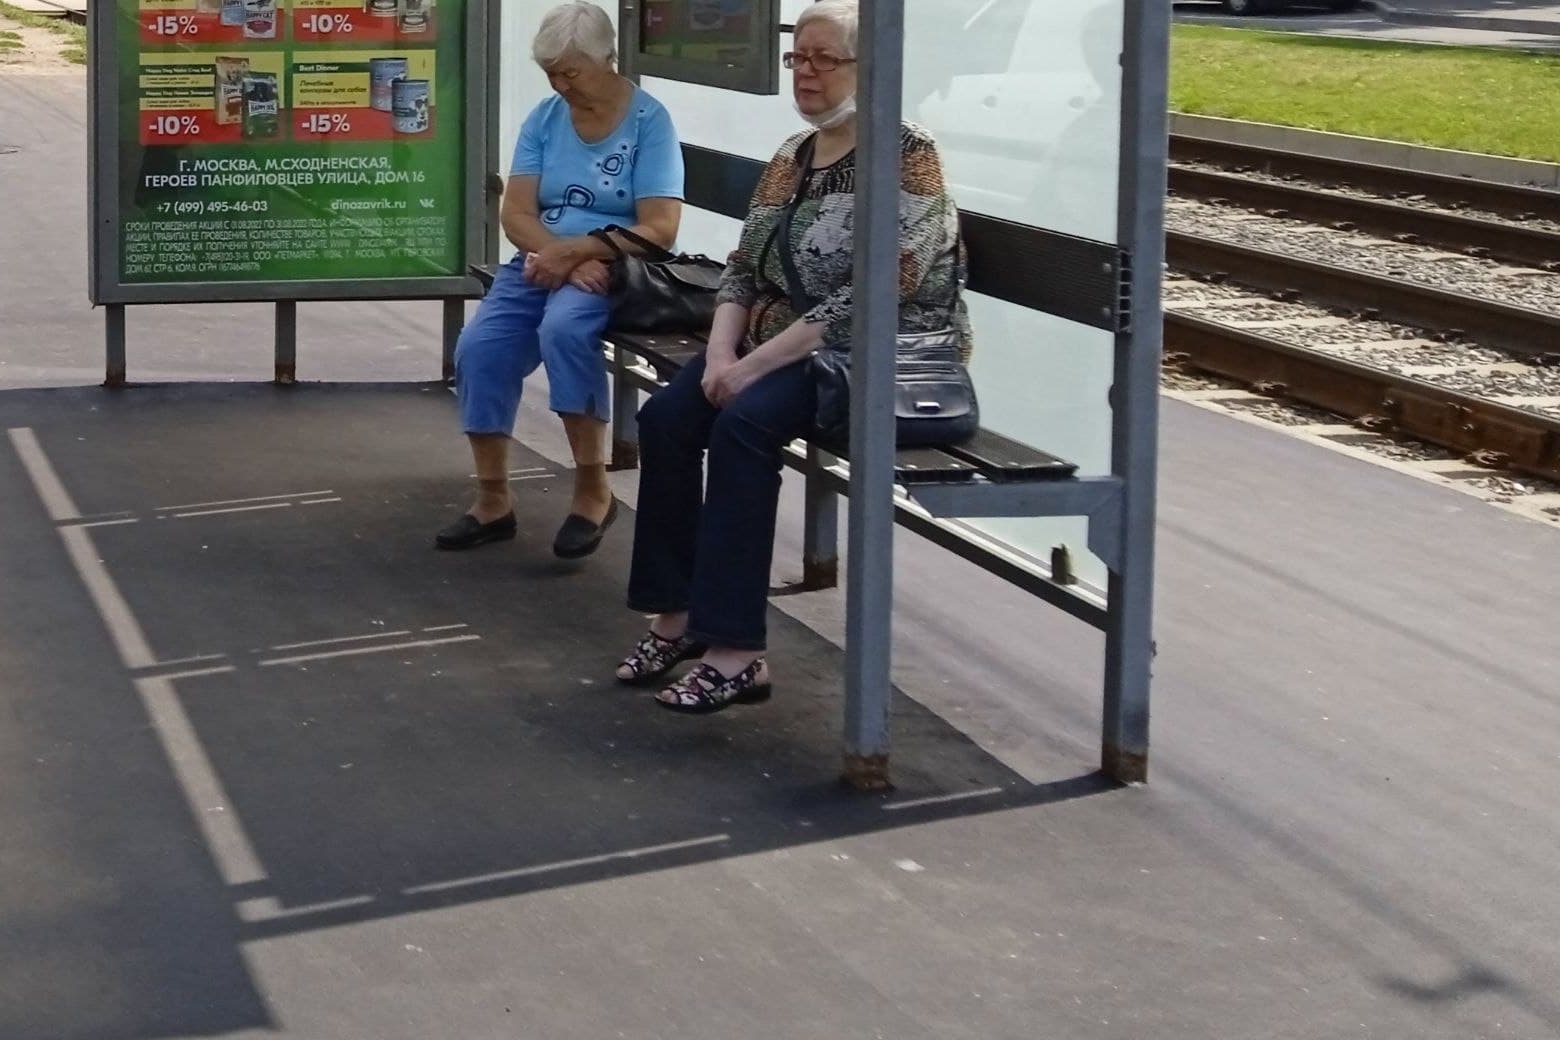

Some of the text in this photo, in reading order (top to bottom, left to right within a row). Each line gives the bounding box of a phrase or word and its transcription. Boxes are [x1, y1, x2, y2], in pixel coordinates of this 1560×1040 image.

[148, 15, 198, 35] -15%
[302, 14, 353, 33] -10%
[149, 116, 200, 135] -10%
[302, 114, 350, 133] -15%
[179, 160, 190, 171] Г.
[194, 159, 261, 172] МОСКВА,
[145, 171, 425, 187] ГЕРОЕВ ПАНФИЛОВЦЕВ УЛИЦА, ДОМ 16
[156, 201, 268, 215] +7 (499) 495-46-03
[331, 198, 406, 209] dinozavrik.ru
